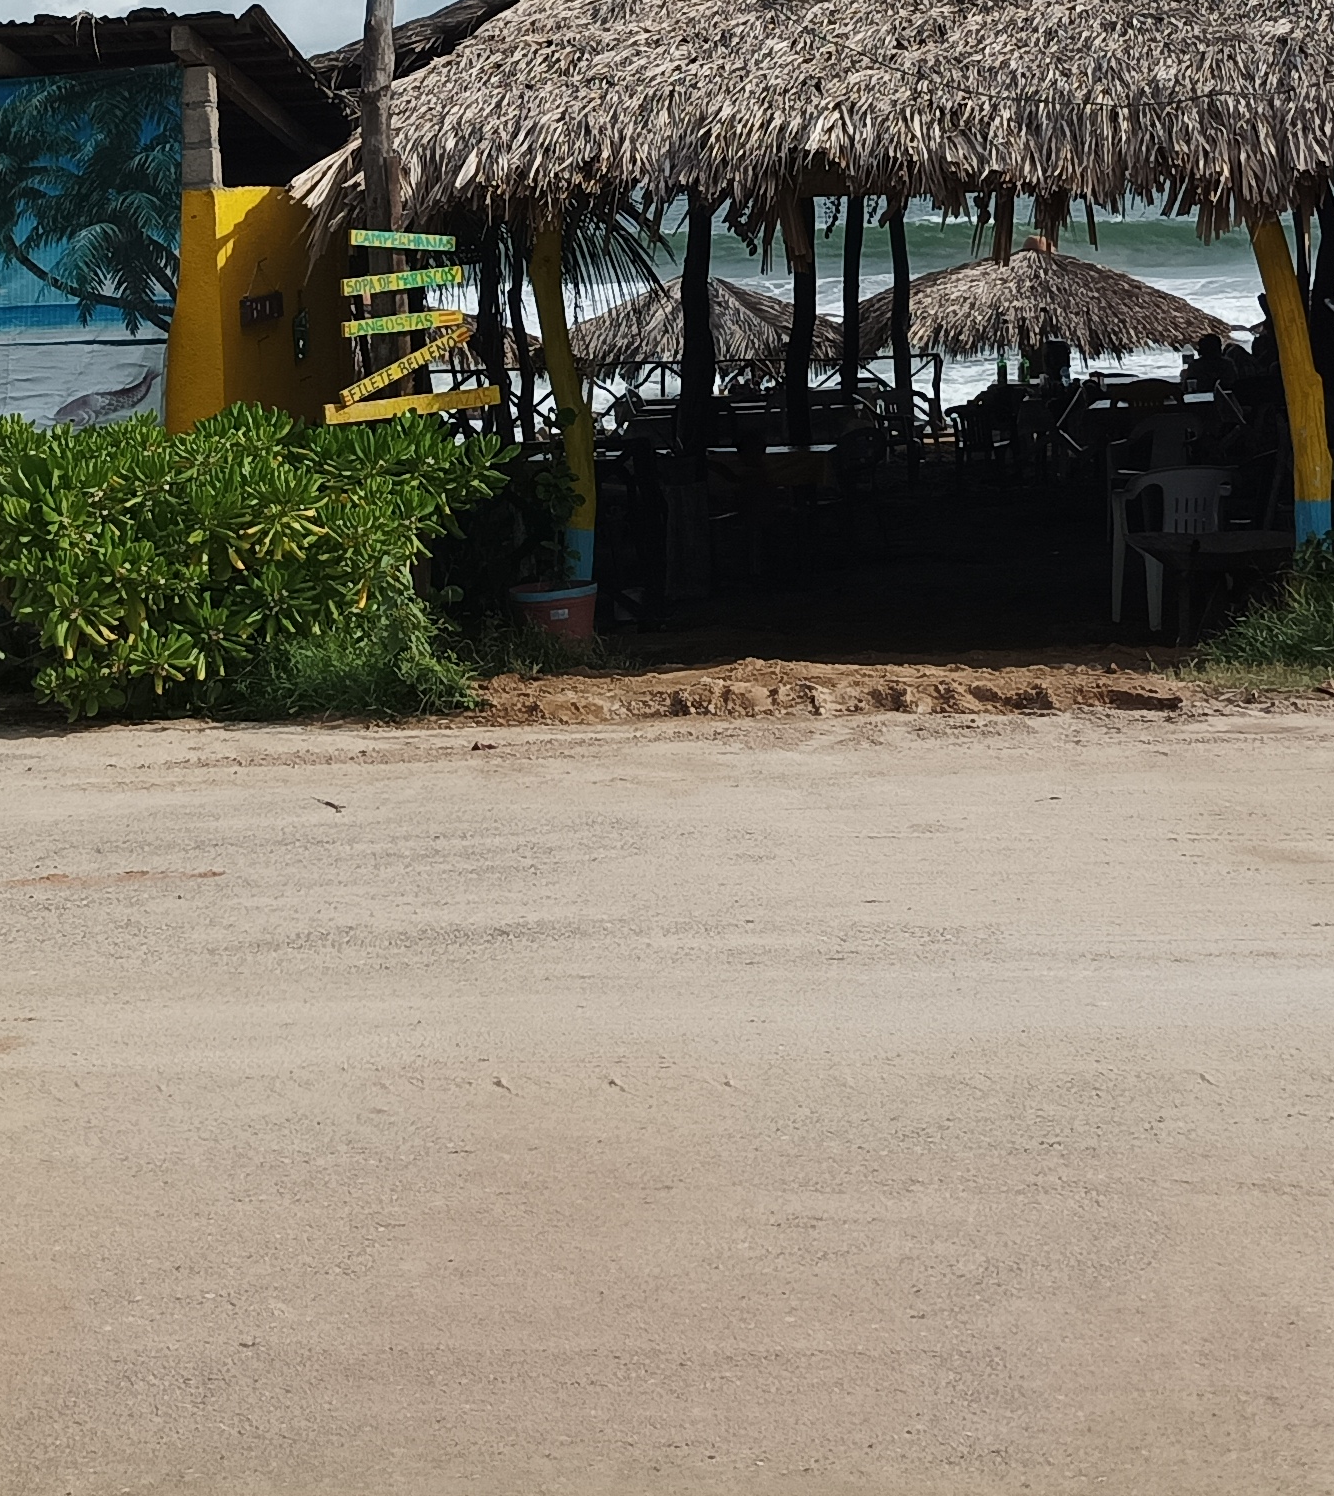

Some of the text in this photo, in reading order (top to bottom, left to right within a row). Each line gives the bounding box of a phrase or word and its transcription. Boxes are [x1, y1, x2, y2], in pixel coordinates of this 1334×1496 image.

[354, 231, 454, 250] CAMPECHANAS
[346, 278, 376, 294] SOPA
[396, 268, 456, 287] MARISCOS
[348, 314, 434, 336] LANGOSTAS
[349, 368, 394, 403] FILETE
[397, 335, 457, 375] RELLENO
